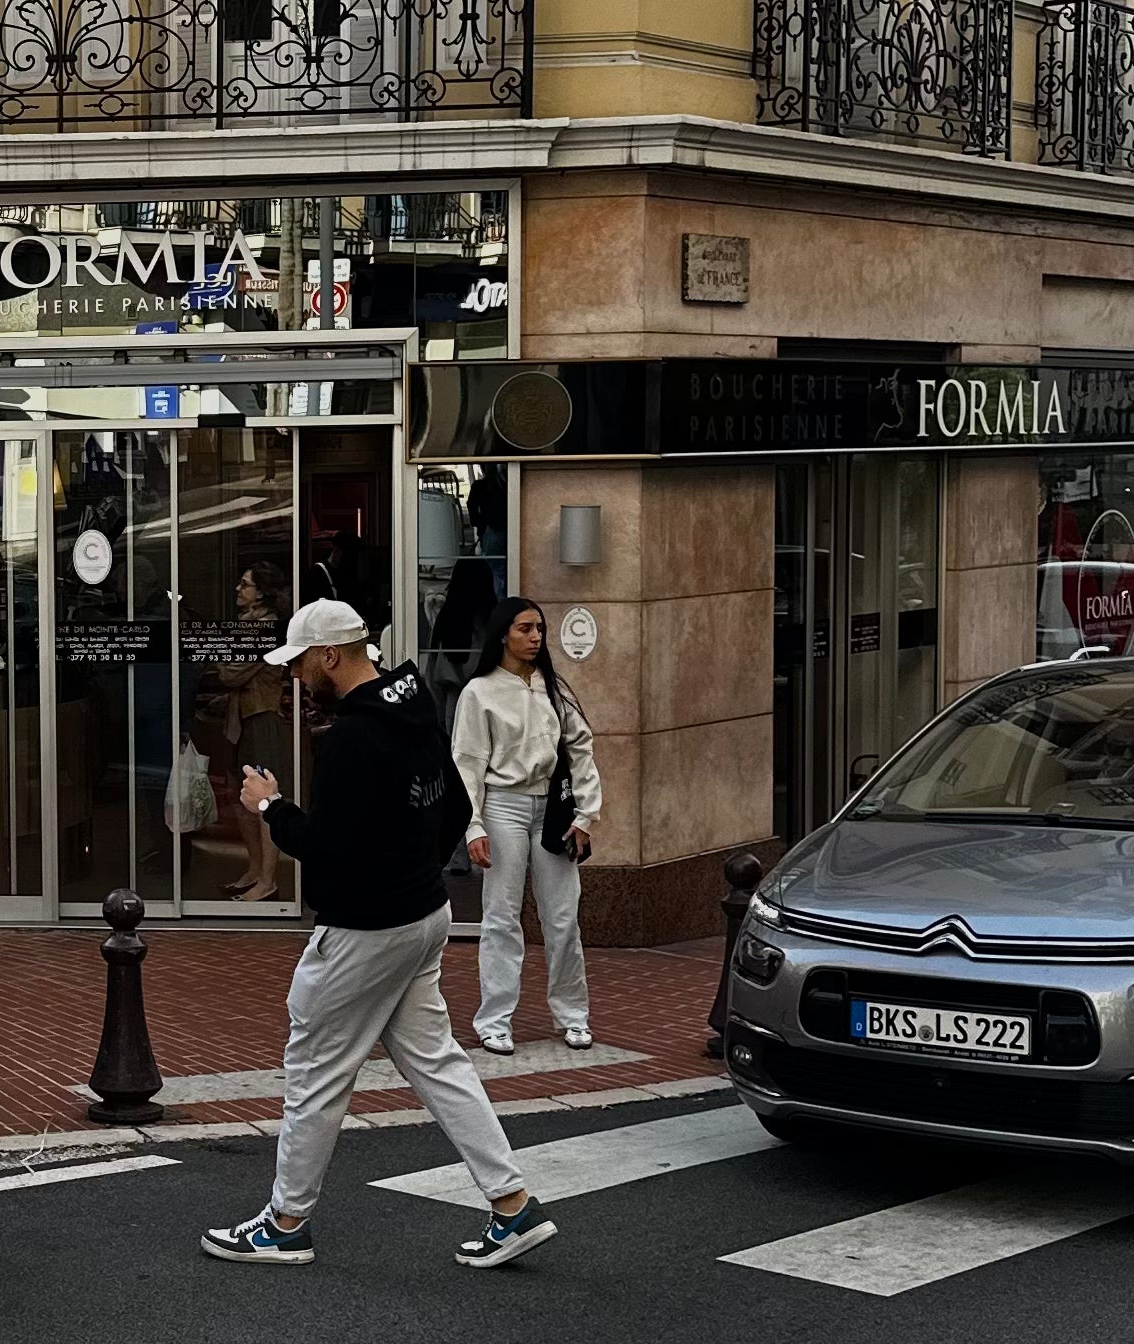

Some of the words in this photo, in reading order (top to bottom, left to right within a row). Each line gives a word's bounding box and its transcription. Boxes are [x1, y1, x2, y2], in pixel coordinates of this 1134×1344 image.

[122, 294, 273, 312] PARISIENNE
[690, 373, 843, 400] BOUCHERIE
[916, 378, 1067, 437] FORMIA
[690, 414, 843, 442] PARISIENNE
[1086, 594, 1133, 620] FORMIA
[855, 1022, 863, 1031] D
[868, 1006, 917, 1039] BKS
[935, 1013, 969, 1044] LS
[975, 1017, 1025, 1050] 222
